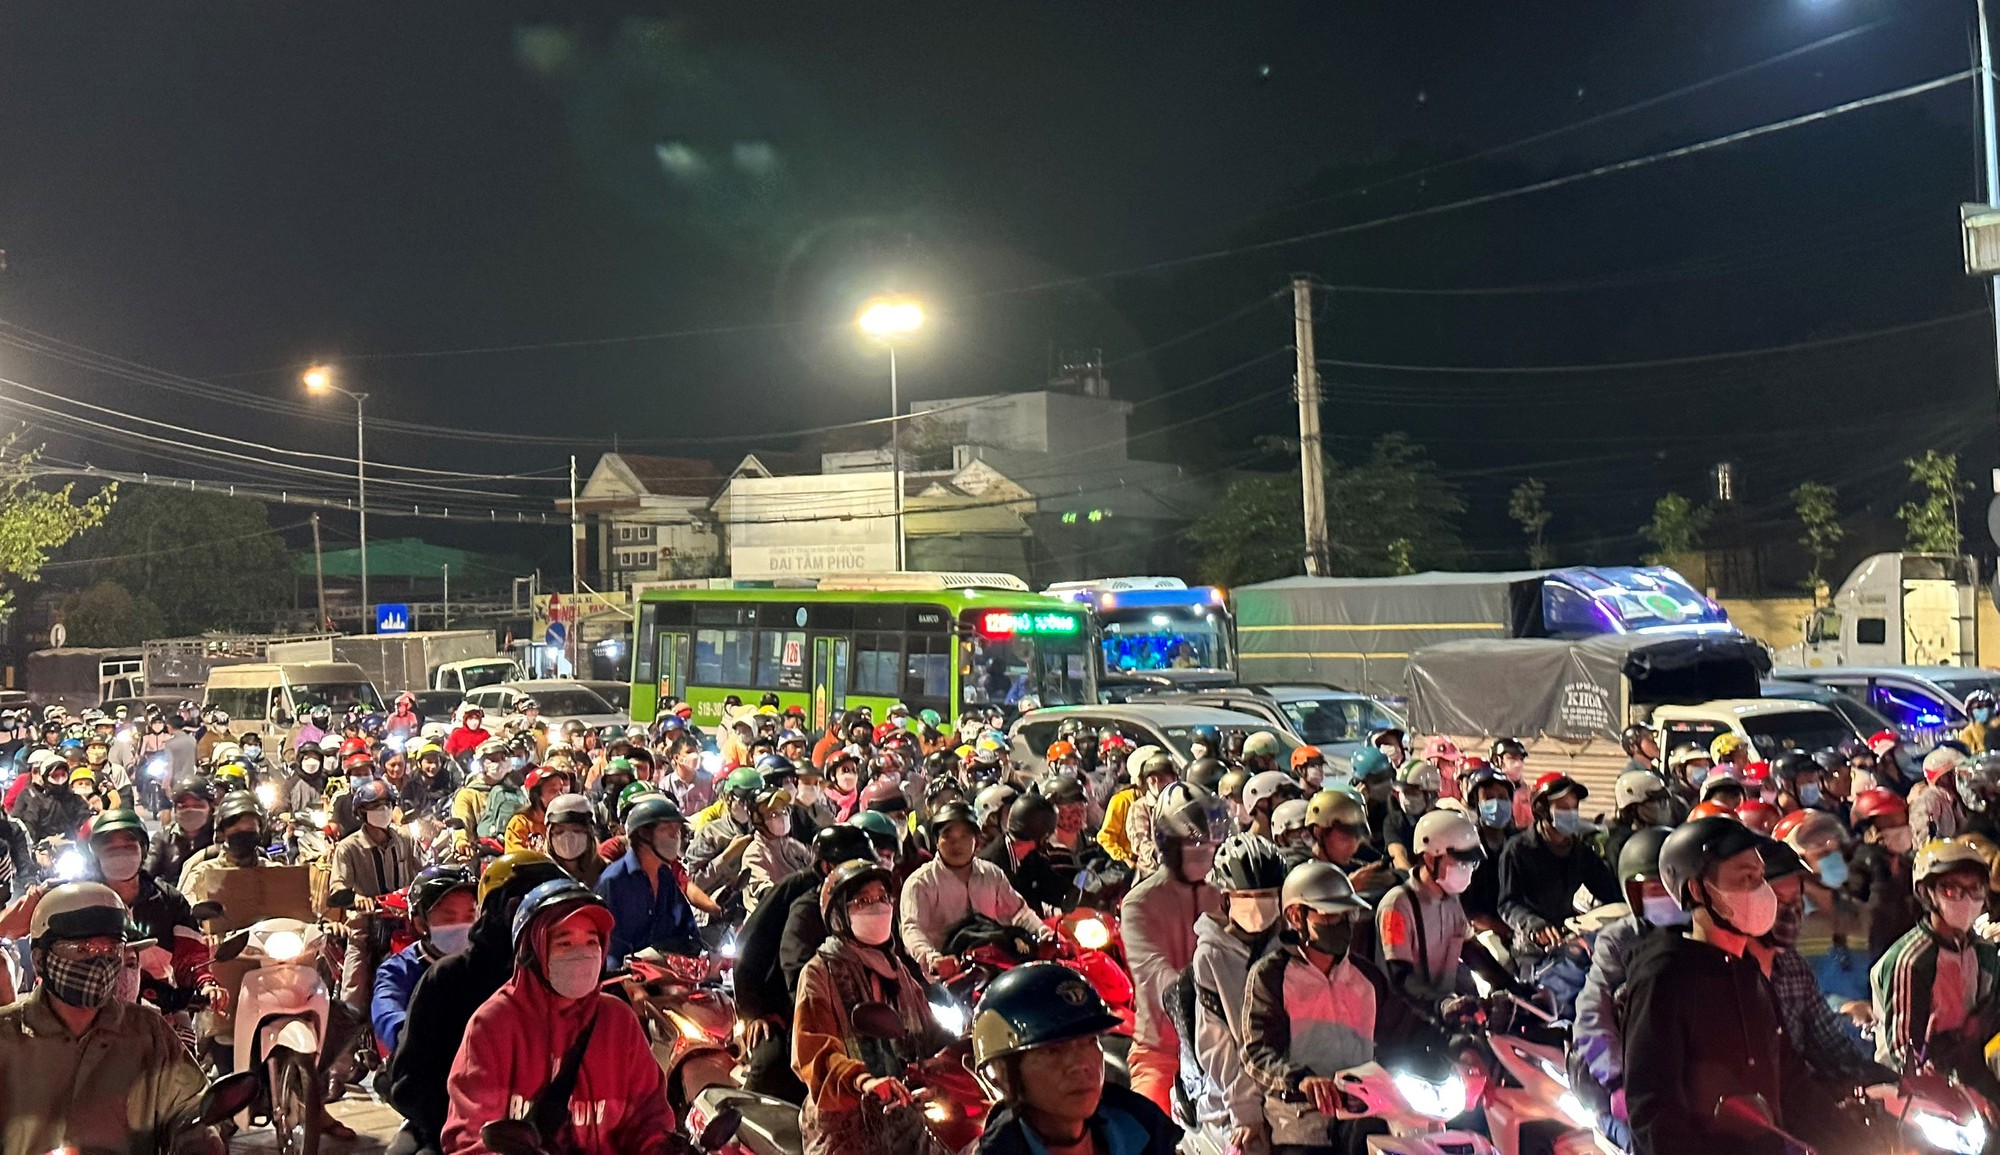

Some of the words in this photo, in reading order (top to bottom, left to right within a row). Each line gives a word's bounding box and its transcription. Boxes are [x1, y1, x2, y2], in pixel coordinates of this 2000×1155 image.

[795, 552, 823, 570] TÂM
[827, 552, 865, 569] PHÚC
[786, 642, 799, 663] 126
